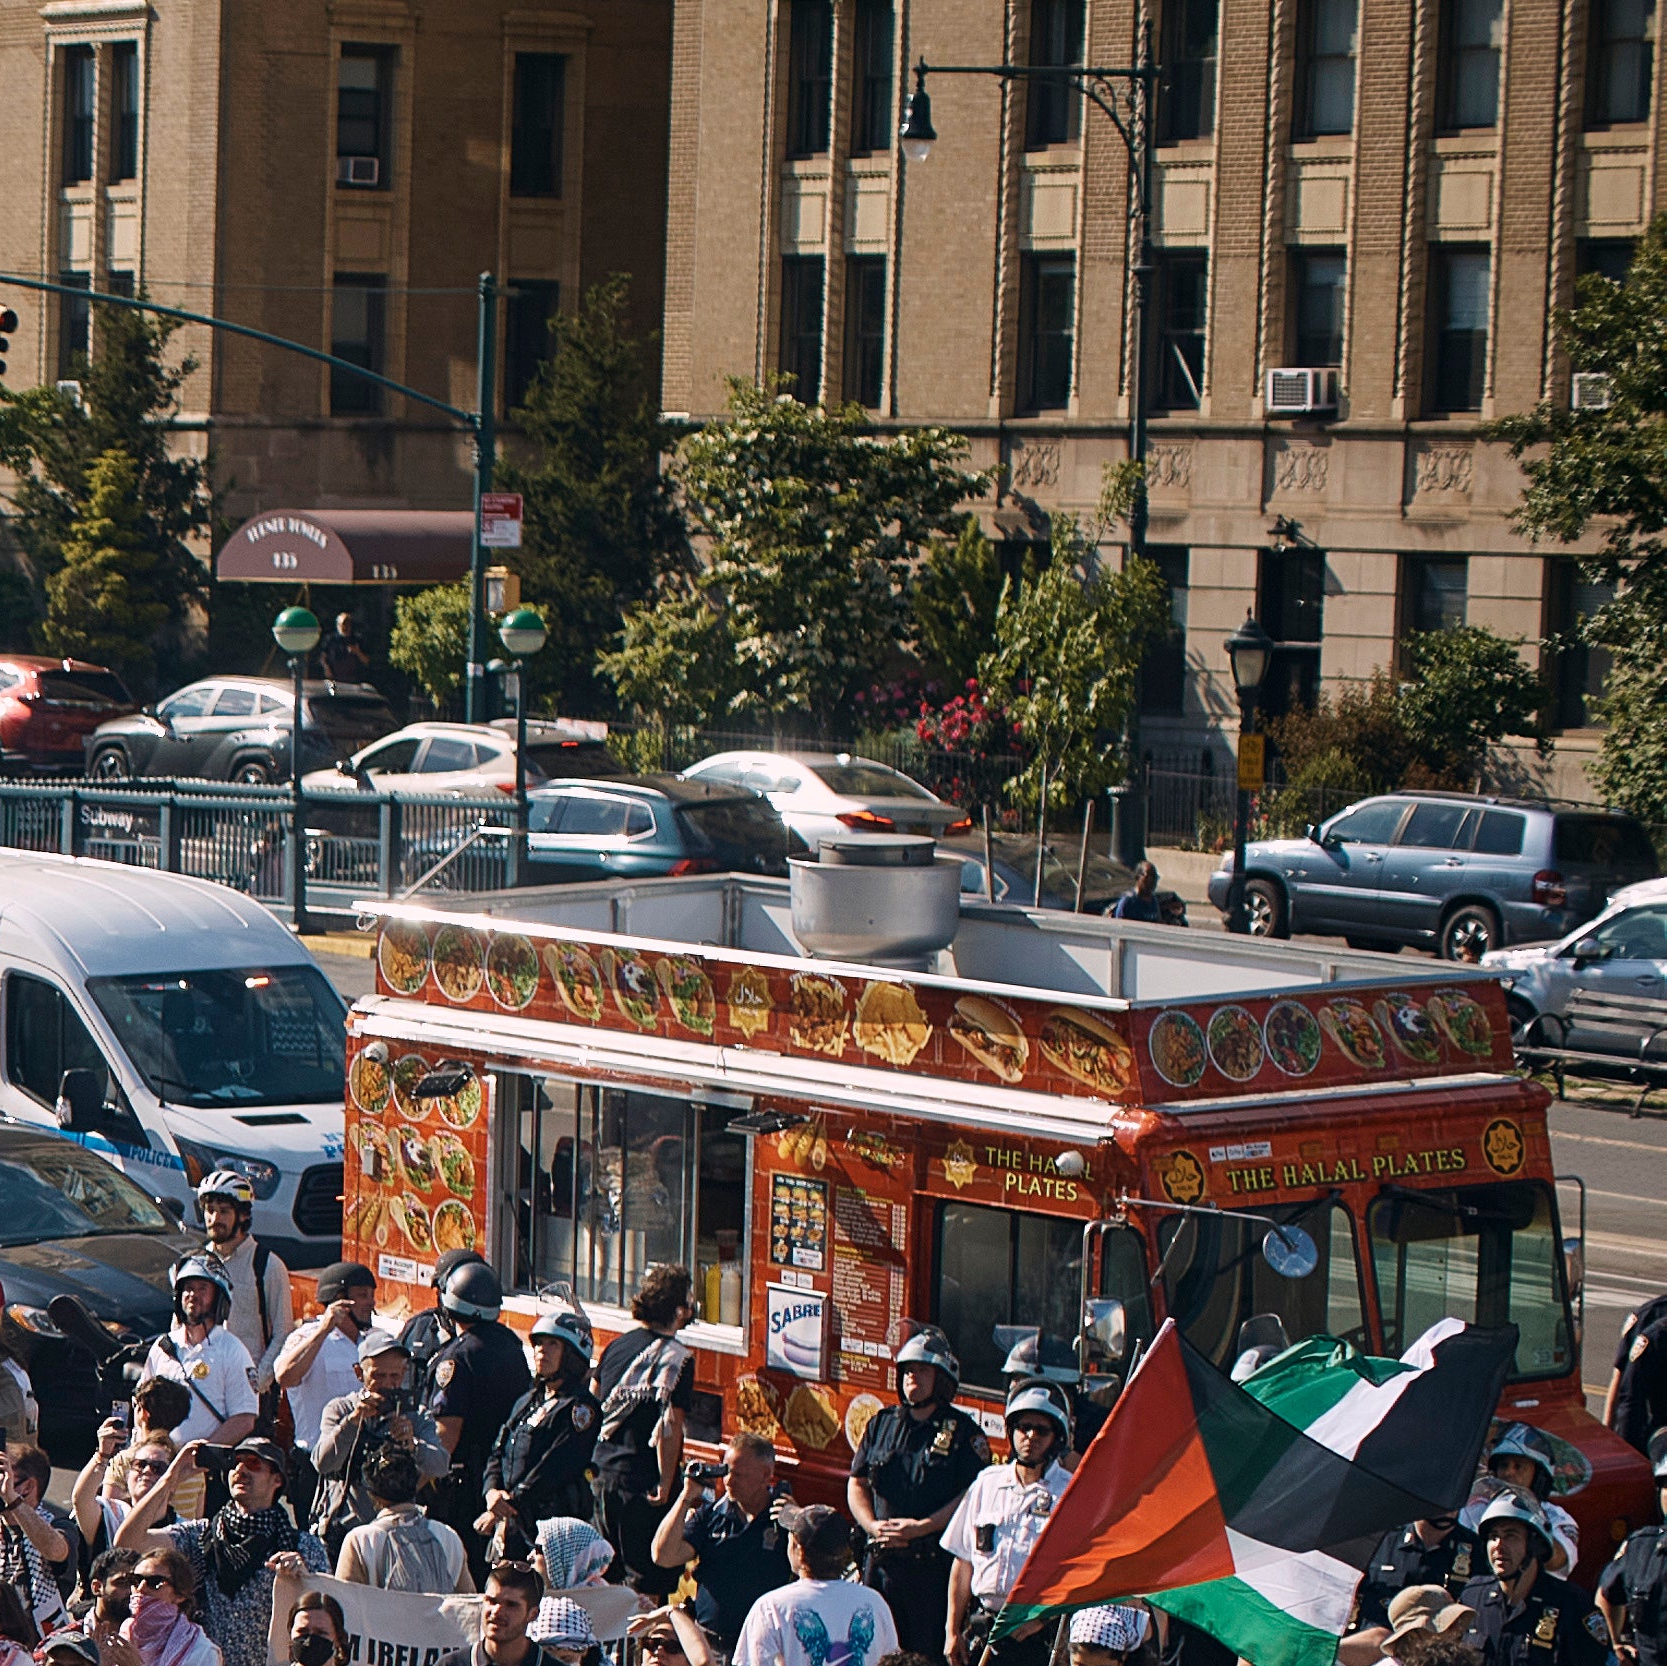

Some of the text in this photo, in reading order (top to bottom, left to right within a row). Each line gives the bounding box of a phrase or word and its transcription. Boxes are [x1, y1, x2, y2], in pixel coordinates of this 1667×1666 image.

[82, 806, 133, 832] Subway
[130, 1146, 171, 1166] POLICE
[985, 1146, 1022, 1169] THE
[1227, 1148, 1466, 1192] THE HALAL PLATES
[1006, 1174, 1078, 1201] PLATES
